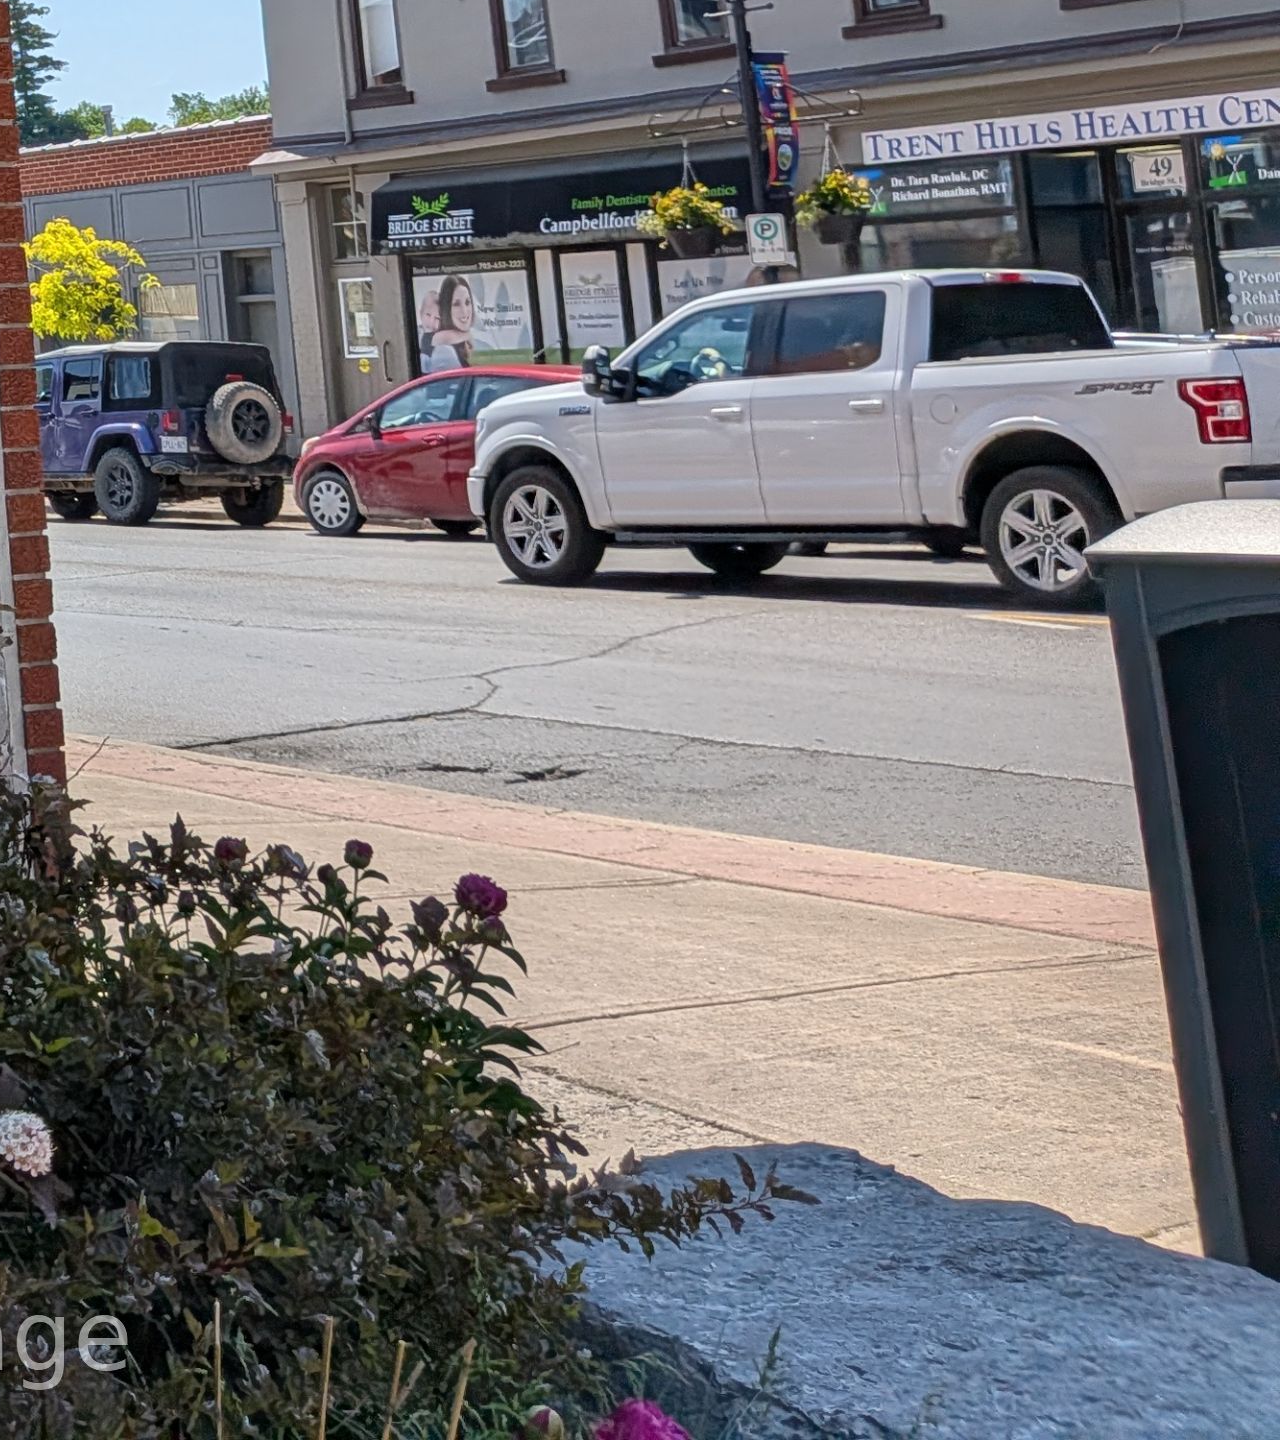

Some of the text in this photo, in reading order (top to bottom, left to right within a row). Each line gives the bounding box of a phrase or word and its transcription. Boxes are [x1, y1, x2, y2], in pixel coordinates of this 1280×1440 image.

[866, 129, 965, 162] TRENT
[973, 119, 1063, 152] HILLS
[1072, 104, 1209, 142] HEALTH
[1149, 156, 1172, 177] 49
[890, 176, 906, 188] Dr.
[908, 174, 930, 187] Tara
[972, 168, 989, 181] DC
[892, 188, 930, 203] Richard
[981, 182, 1008, 195] RMT
[571, 195, 604, 212] Family
[388, 216, 474, 235] BRIDGE STREET
[760, 223, 772, 236] P
[388, 235, 474, 249] DENTAL CENTRE
[477, 302, 524, 313] New Smiles
[481, 317, 521, 328] Welcome!
[1074, 379, 1165, 396] SPORT
